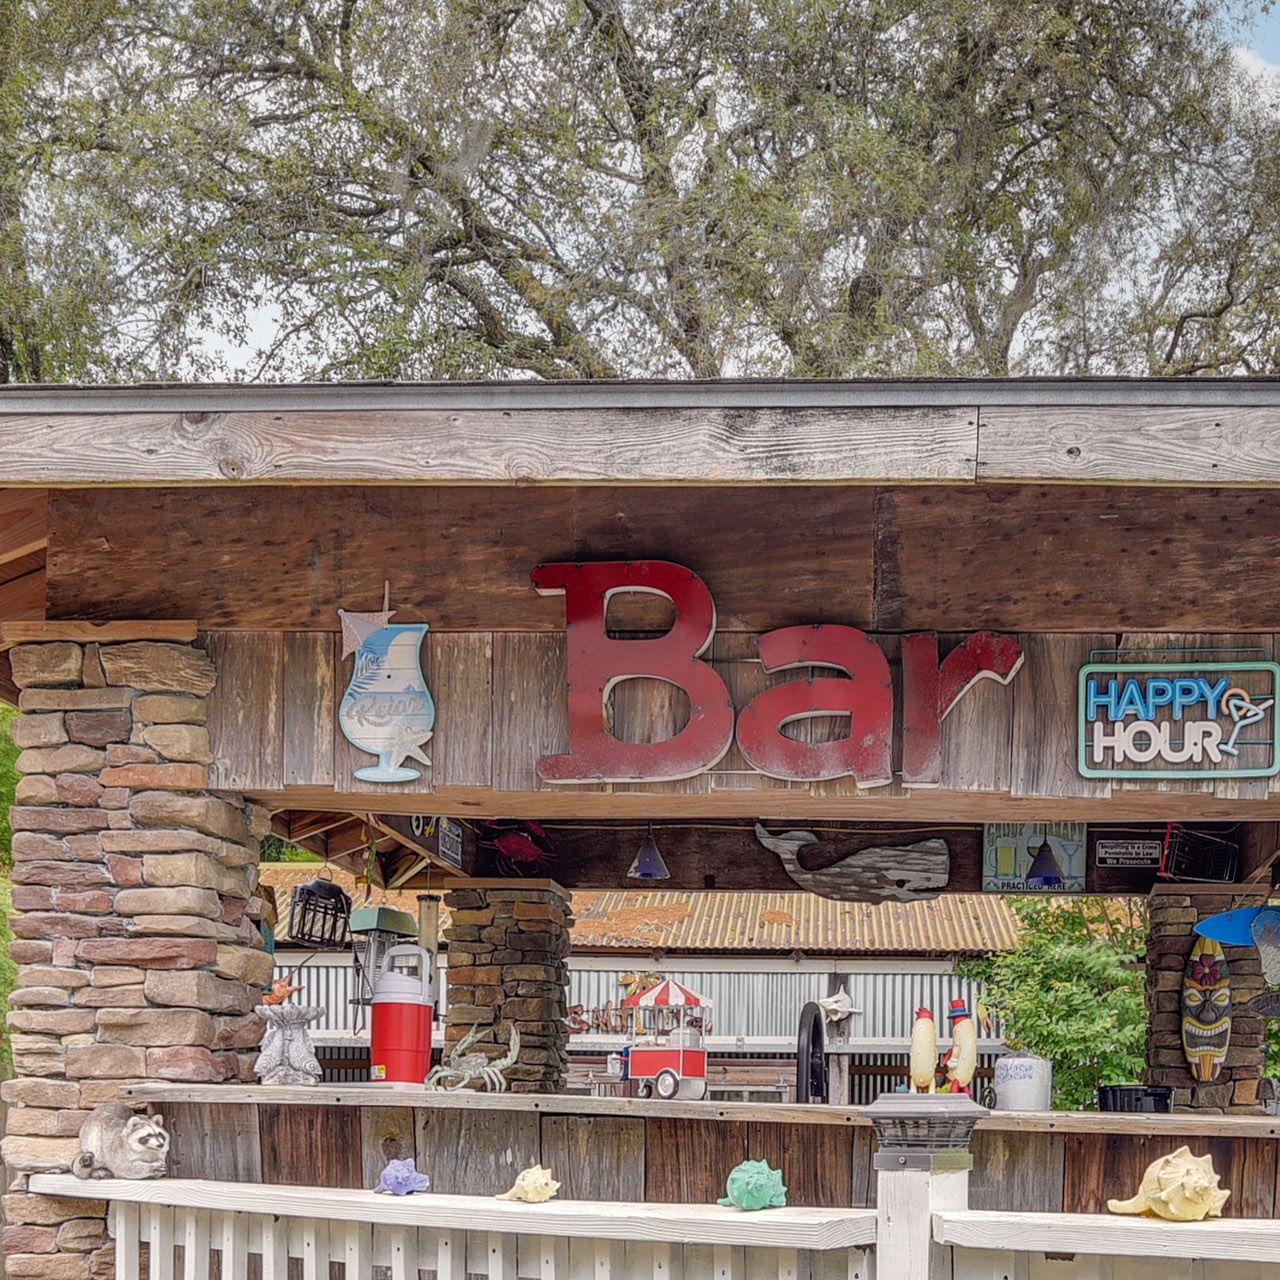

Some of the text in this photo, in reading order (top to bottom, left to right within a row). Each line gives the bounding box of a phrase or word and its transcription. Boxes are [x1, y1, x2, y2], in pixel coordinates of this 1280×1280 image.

[531, 560, 1025, 788] Bar
[1087, 675, 1230, 721] HAPPY
[1093, 720, 1223, 764] HOUR
